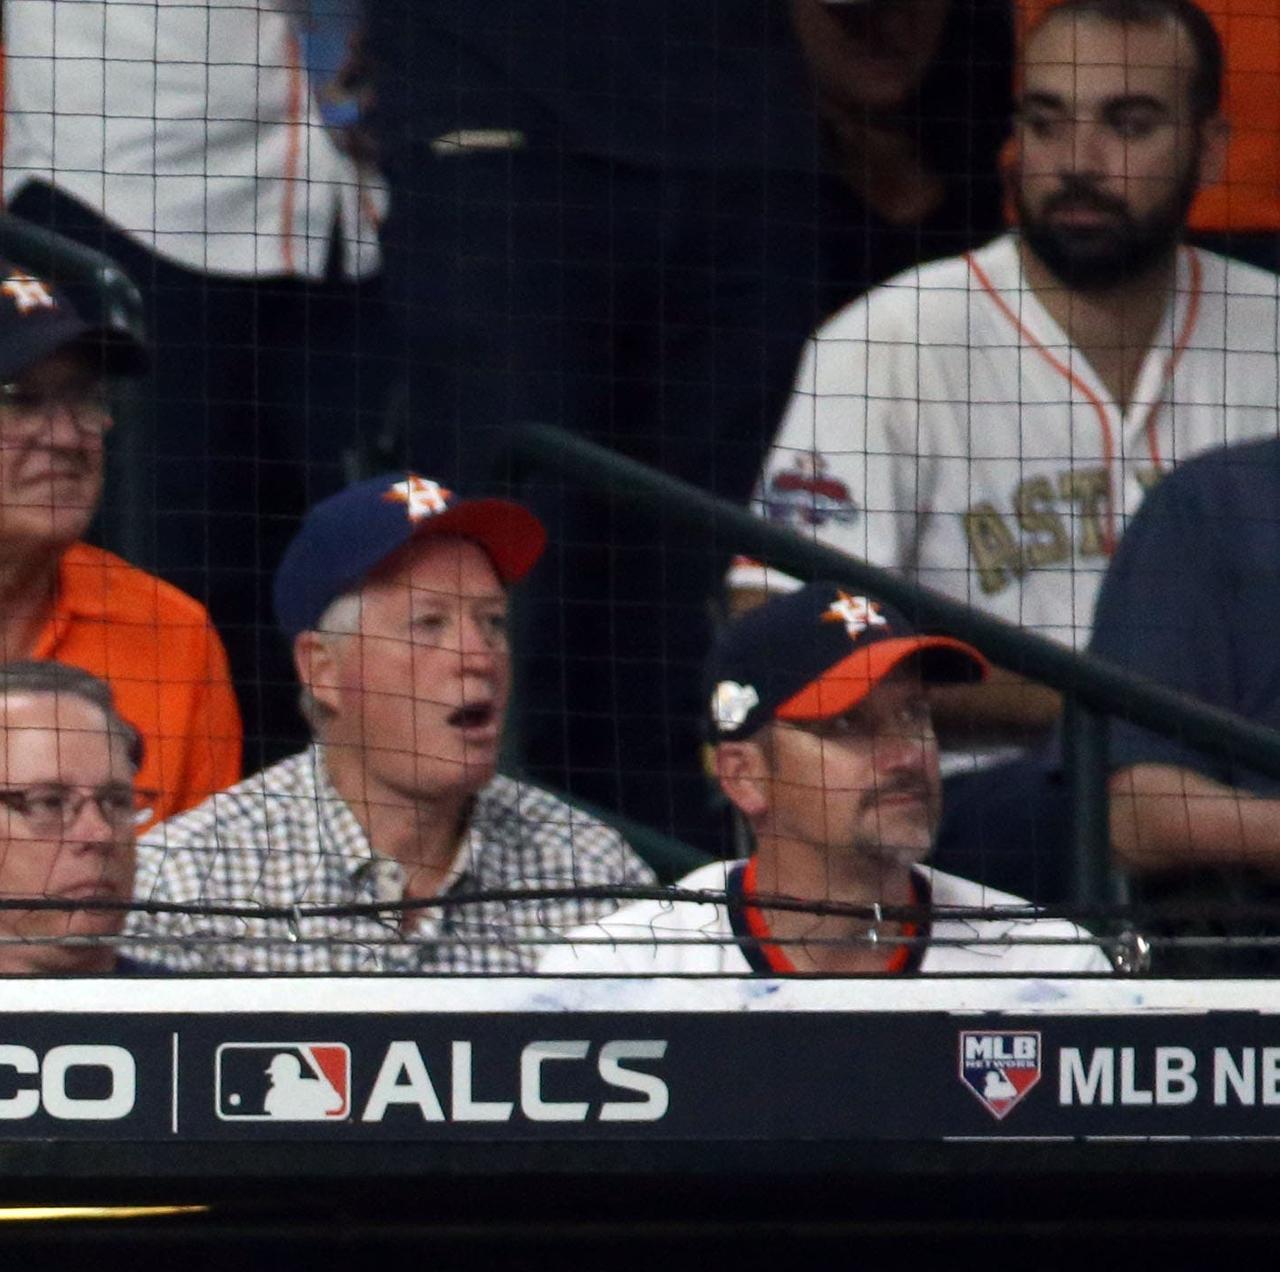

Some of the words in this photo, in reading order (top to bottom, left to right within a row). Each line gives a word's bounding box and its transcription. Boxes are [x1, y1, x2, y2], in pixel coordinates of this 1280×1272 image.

[965, 1036, 1036, 1059] MLB
[1060, 1047, 1197, 1105] MLB
[361, 1040, 669, 1122] ALCS
